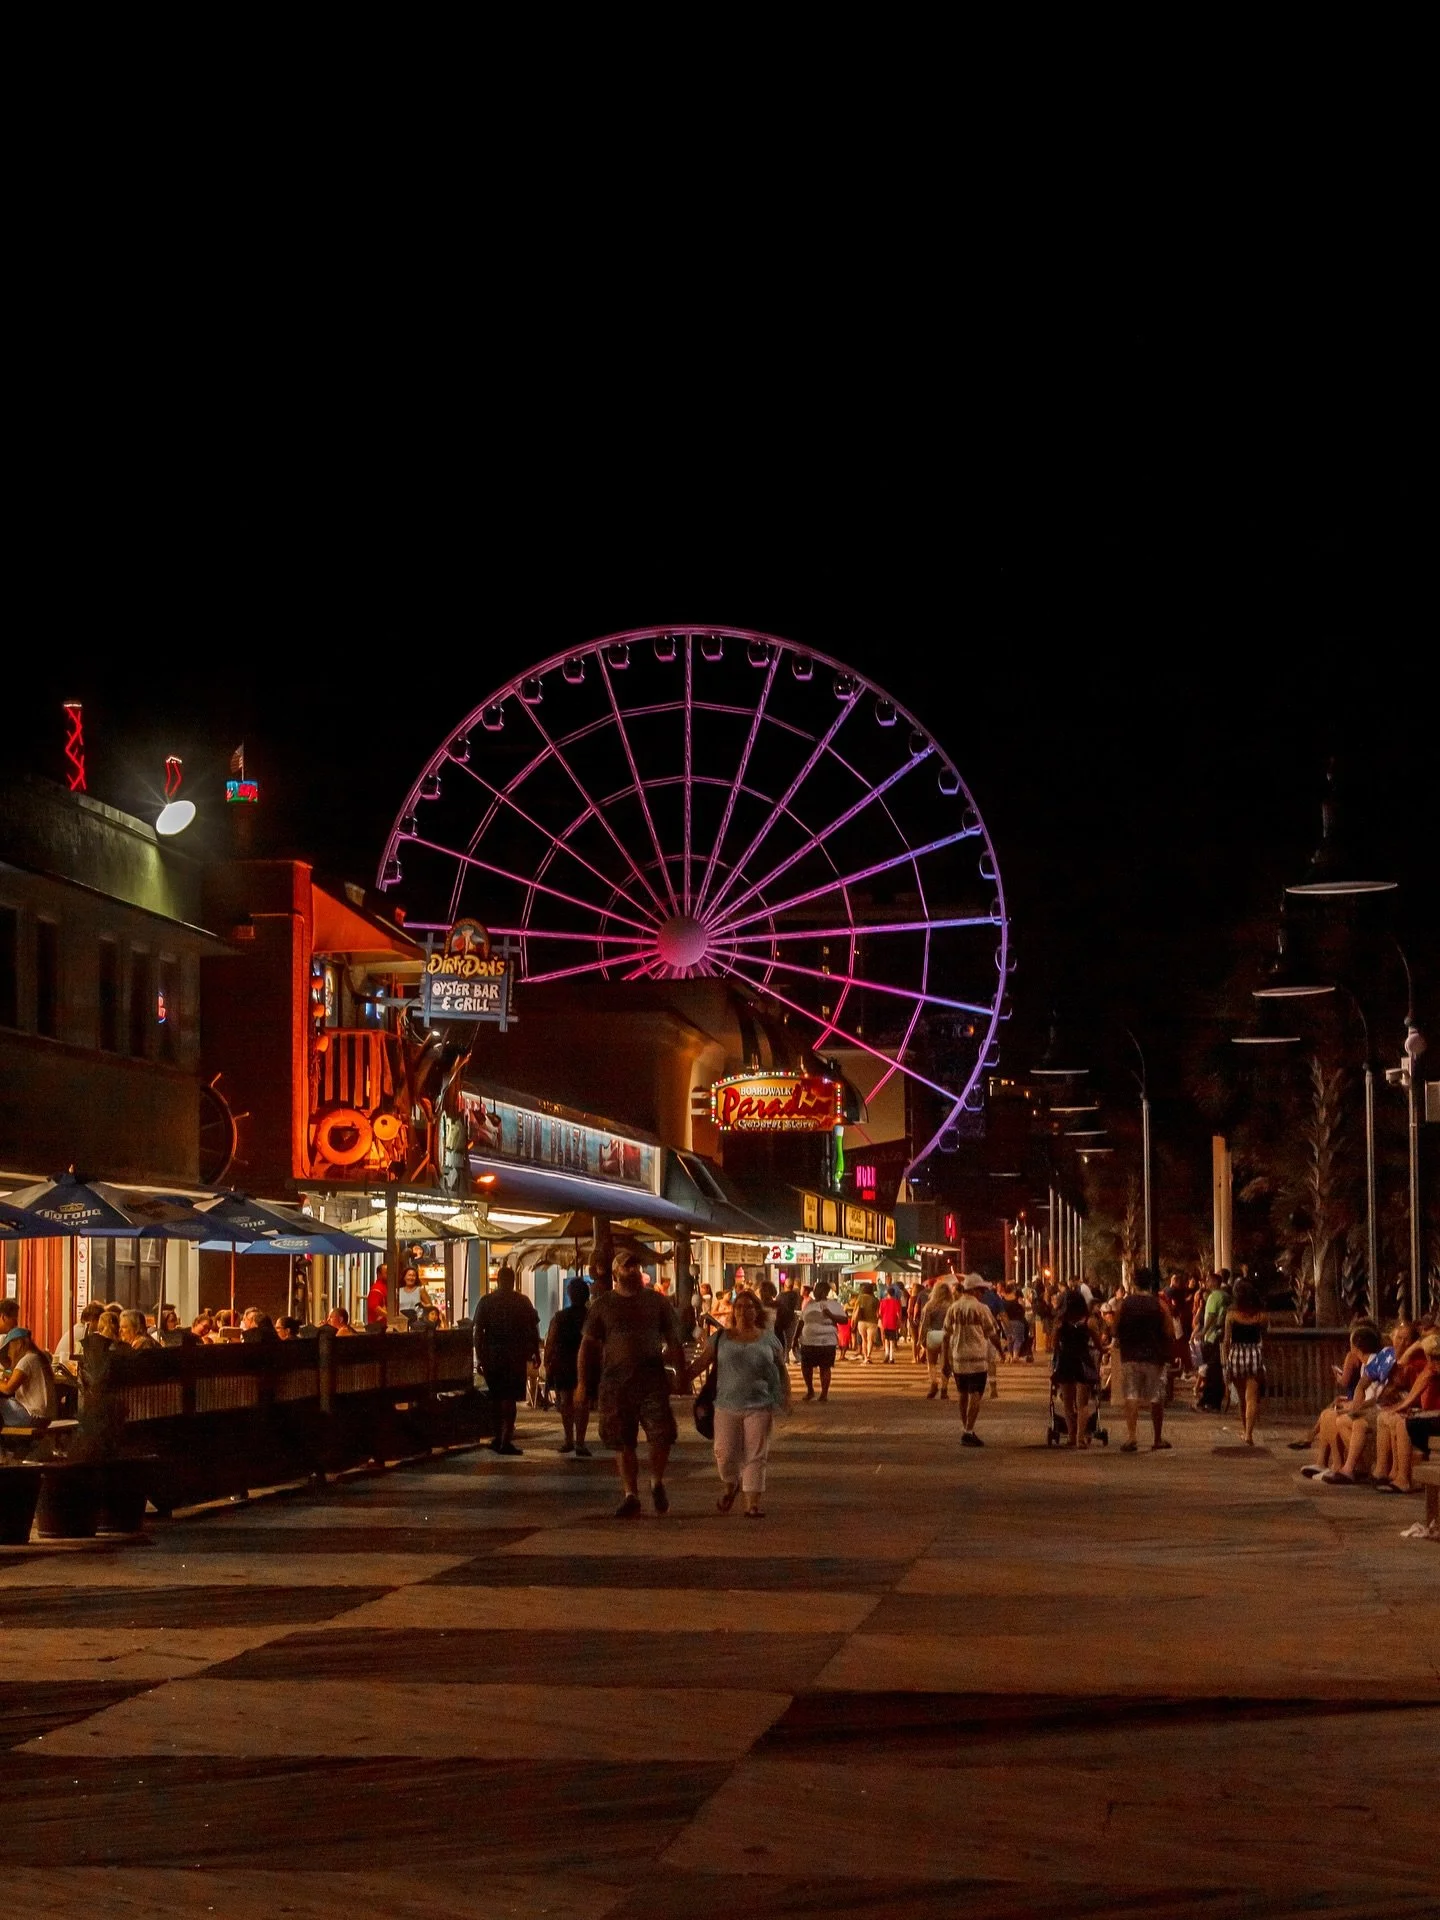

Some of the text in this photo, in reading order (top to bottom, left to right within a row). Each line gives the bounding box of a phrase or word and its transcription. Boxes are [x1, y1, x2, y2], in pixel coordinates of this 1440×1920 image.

[462, 954, 505, 977] DON'S
[432, 980, 499, 999] OYSTER BAR
[441, 996, 489, 1012] & GRILL
[739, 1087, 792, 1097] BOARDWALK
[738, 1119, 815, 1129] General Store
[550, 1119, 589, 1172] PLAZA
[35, 1208, 102, 1220] Corona
